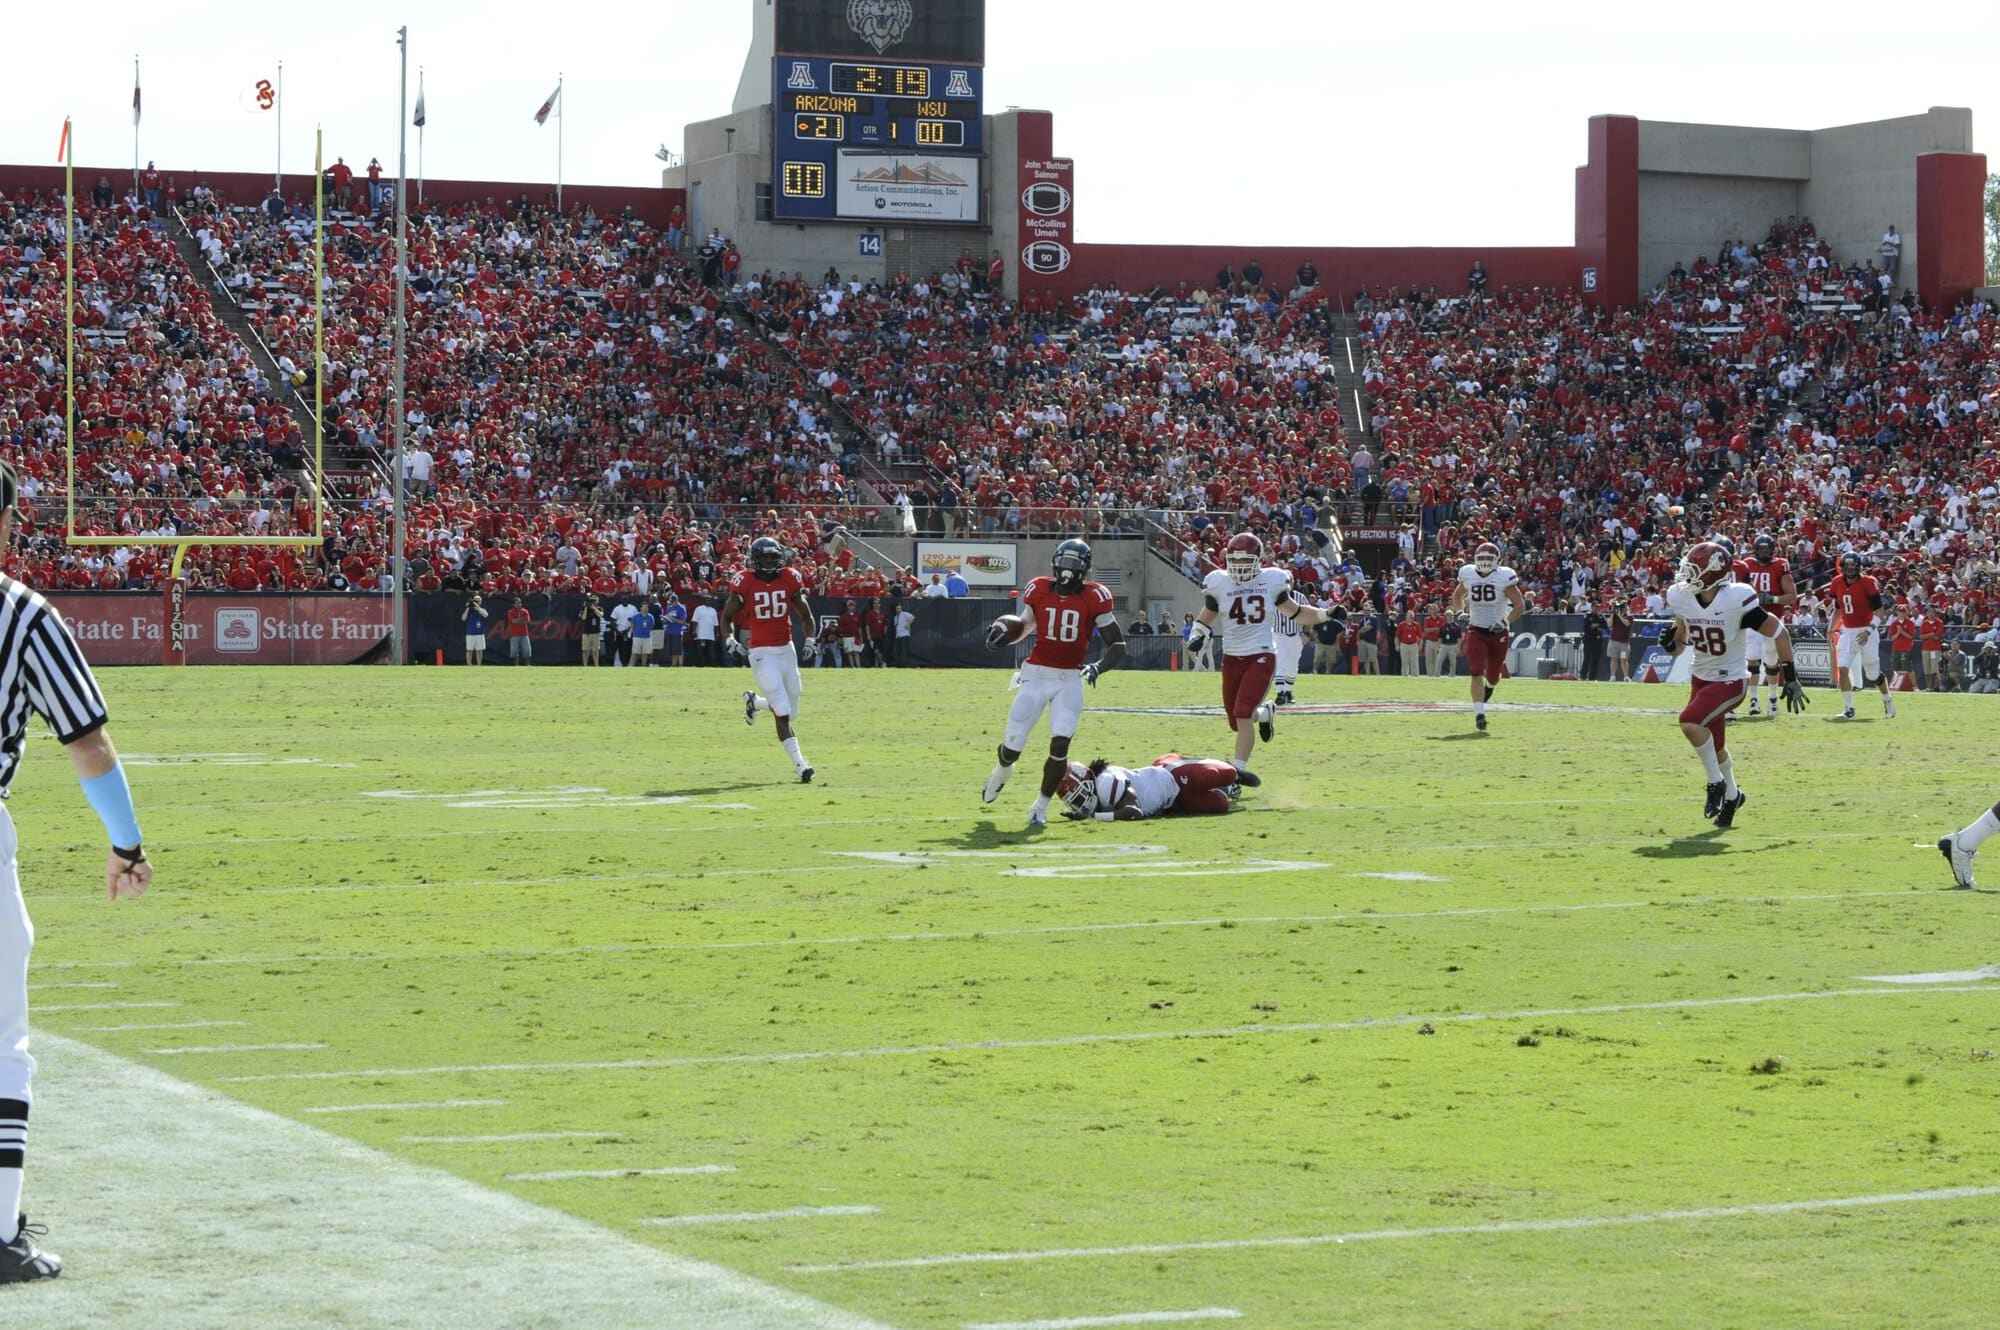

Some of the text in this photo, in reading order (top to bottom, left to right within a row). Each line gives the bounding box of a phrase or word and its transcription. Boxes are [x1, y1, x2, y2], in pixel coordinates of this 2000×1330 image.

[856, 67, 927, 95] 2:19
[795, 95, 857, 113] ARIZONA
[917, 102, 948, 117] WSU
[815, 117, 841, 138] 21
[890, 122, 897, 139] 1
[918, 122, 944, 143] 00
[1025, 160, 1072, 170] John "Button"
[785, 164, 823, 195] 00
[1034, 170, 1059, 179] Salmon
[1026, 219, 1067, 228] McCollins
[1034, 229, 1059, 238] Umeh
[861, 237, 880, 253] 14
[1041, 254, 1053, 262] 90
[1583, 272, 1596, 289] 15
[1360, 529, 1388, 539] SECTION
[1749, 572, 1771, 593] 78
[1471, 584, 1497, 602] 96
[754, 590, 788, 619] 26
[1229, 595, 1265, 625] 43
[1842, 595, 1854, 614] 8
[171, 583, 183, 651] ARIZONA
[1045, 607, 1080, 643] 18
[263, 616, 324, 640] State
[1689, 625, 1727, 656] 28
[1648, 652, 1673, 663] Game
[1796, 653, 1813, 667] SOL
